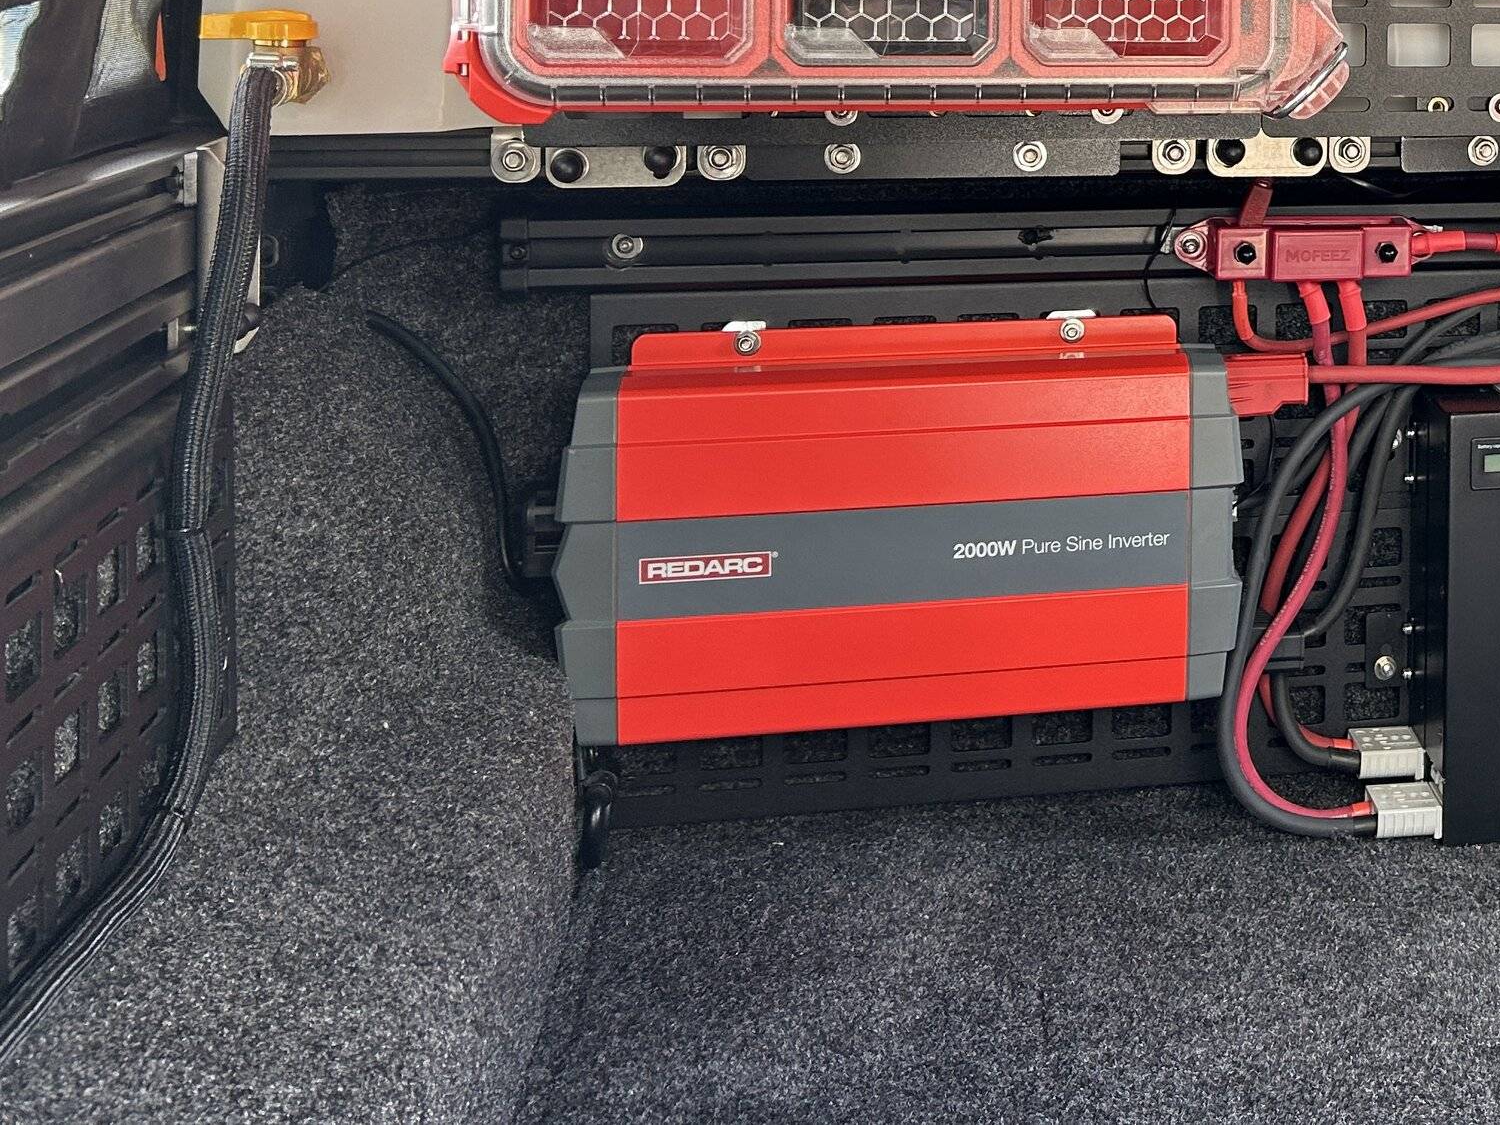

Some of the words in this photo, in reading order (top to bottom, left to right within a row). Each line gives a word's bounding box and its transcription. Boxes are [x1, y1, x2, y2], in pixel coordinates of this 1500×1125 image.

[953, 540, 1017, 559] 2000W
[1022, 538, 1061, 555] Pure
[1066, 535, 1103, 552] Sine
[1108, 531, 1171, 549] Inverter
[648, 556, 764, 579] REDARC
